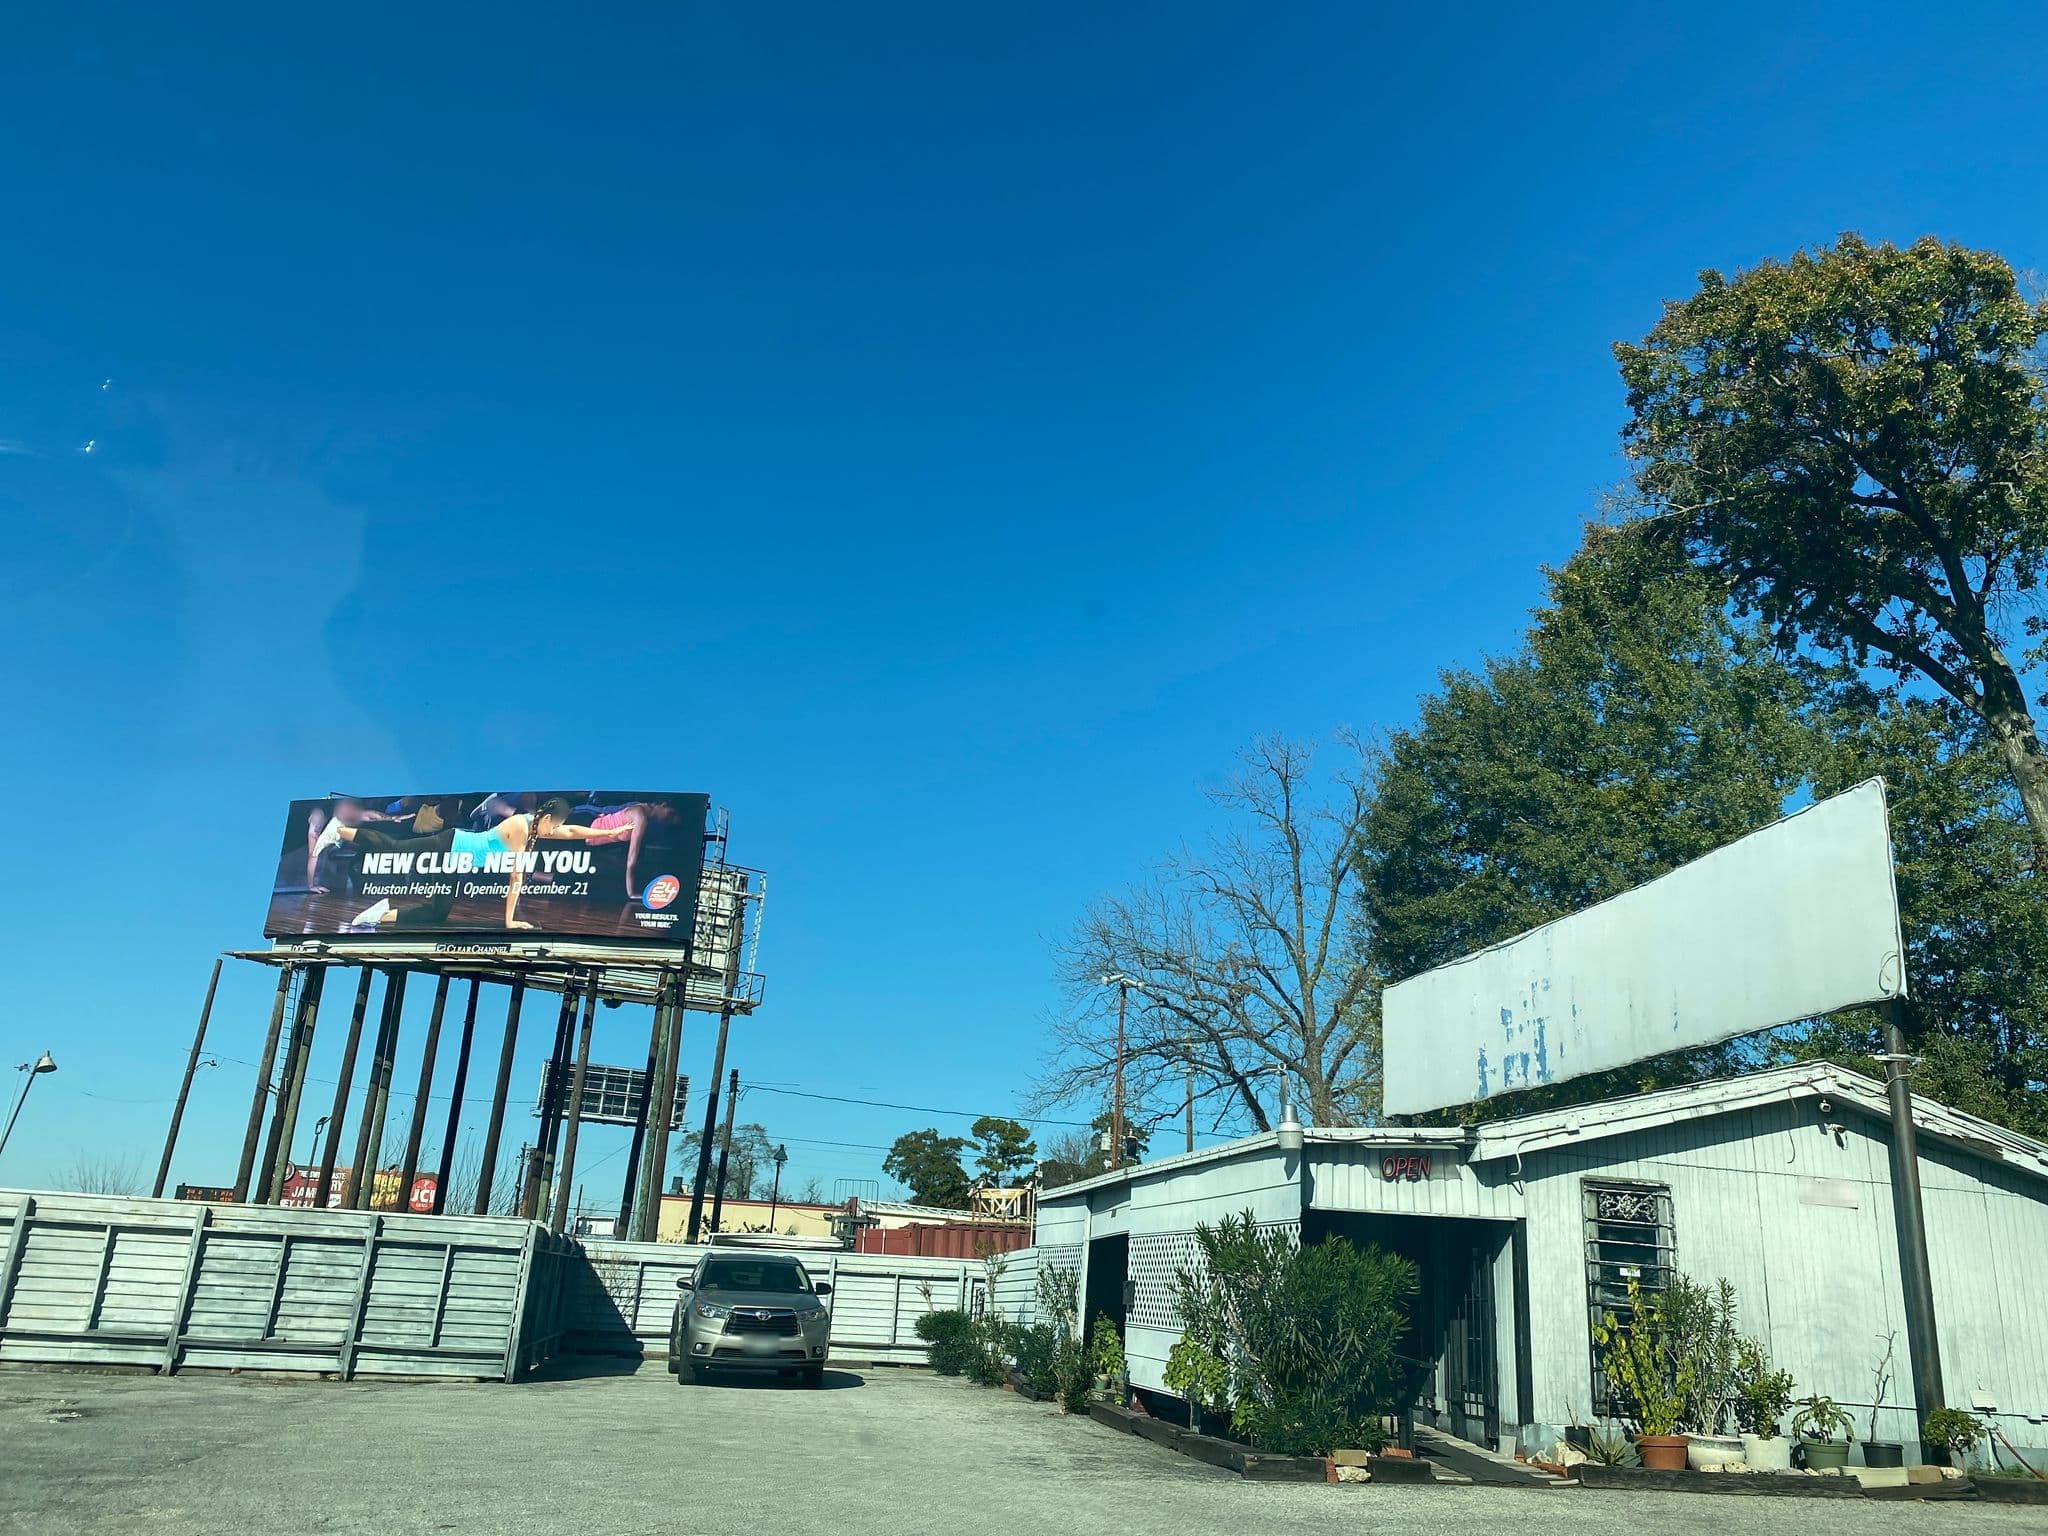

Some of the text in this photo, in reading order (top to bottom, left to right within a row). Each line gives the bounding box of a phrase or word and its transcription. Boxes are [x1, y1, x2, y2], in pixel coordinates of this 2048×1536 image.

[362, 850, 597, 875] NEW CLUB. NEW YOU.
[362, 881, 589, 898] Houston Heights Opening December 21
[651, 881, 677, 899] 24
[1382, 1157, 1431, 1177] OPEN
